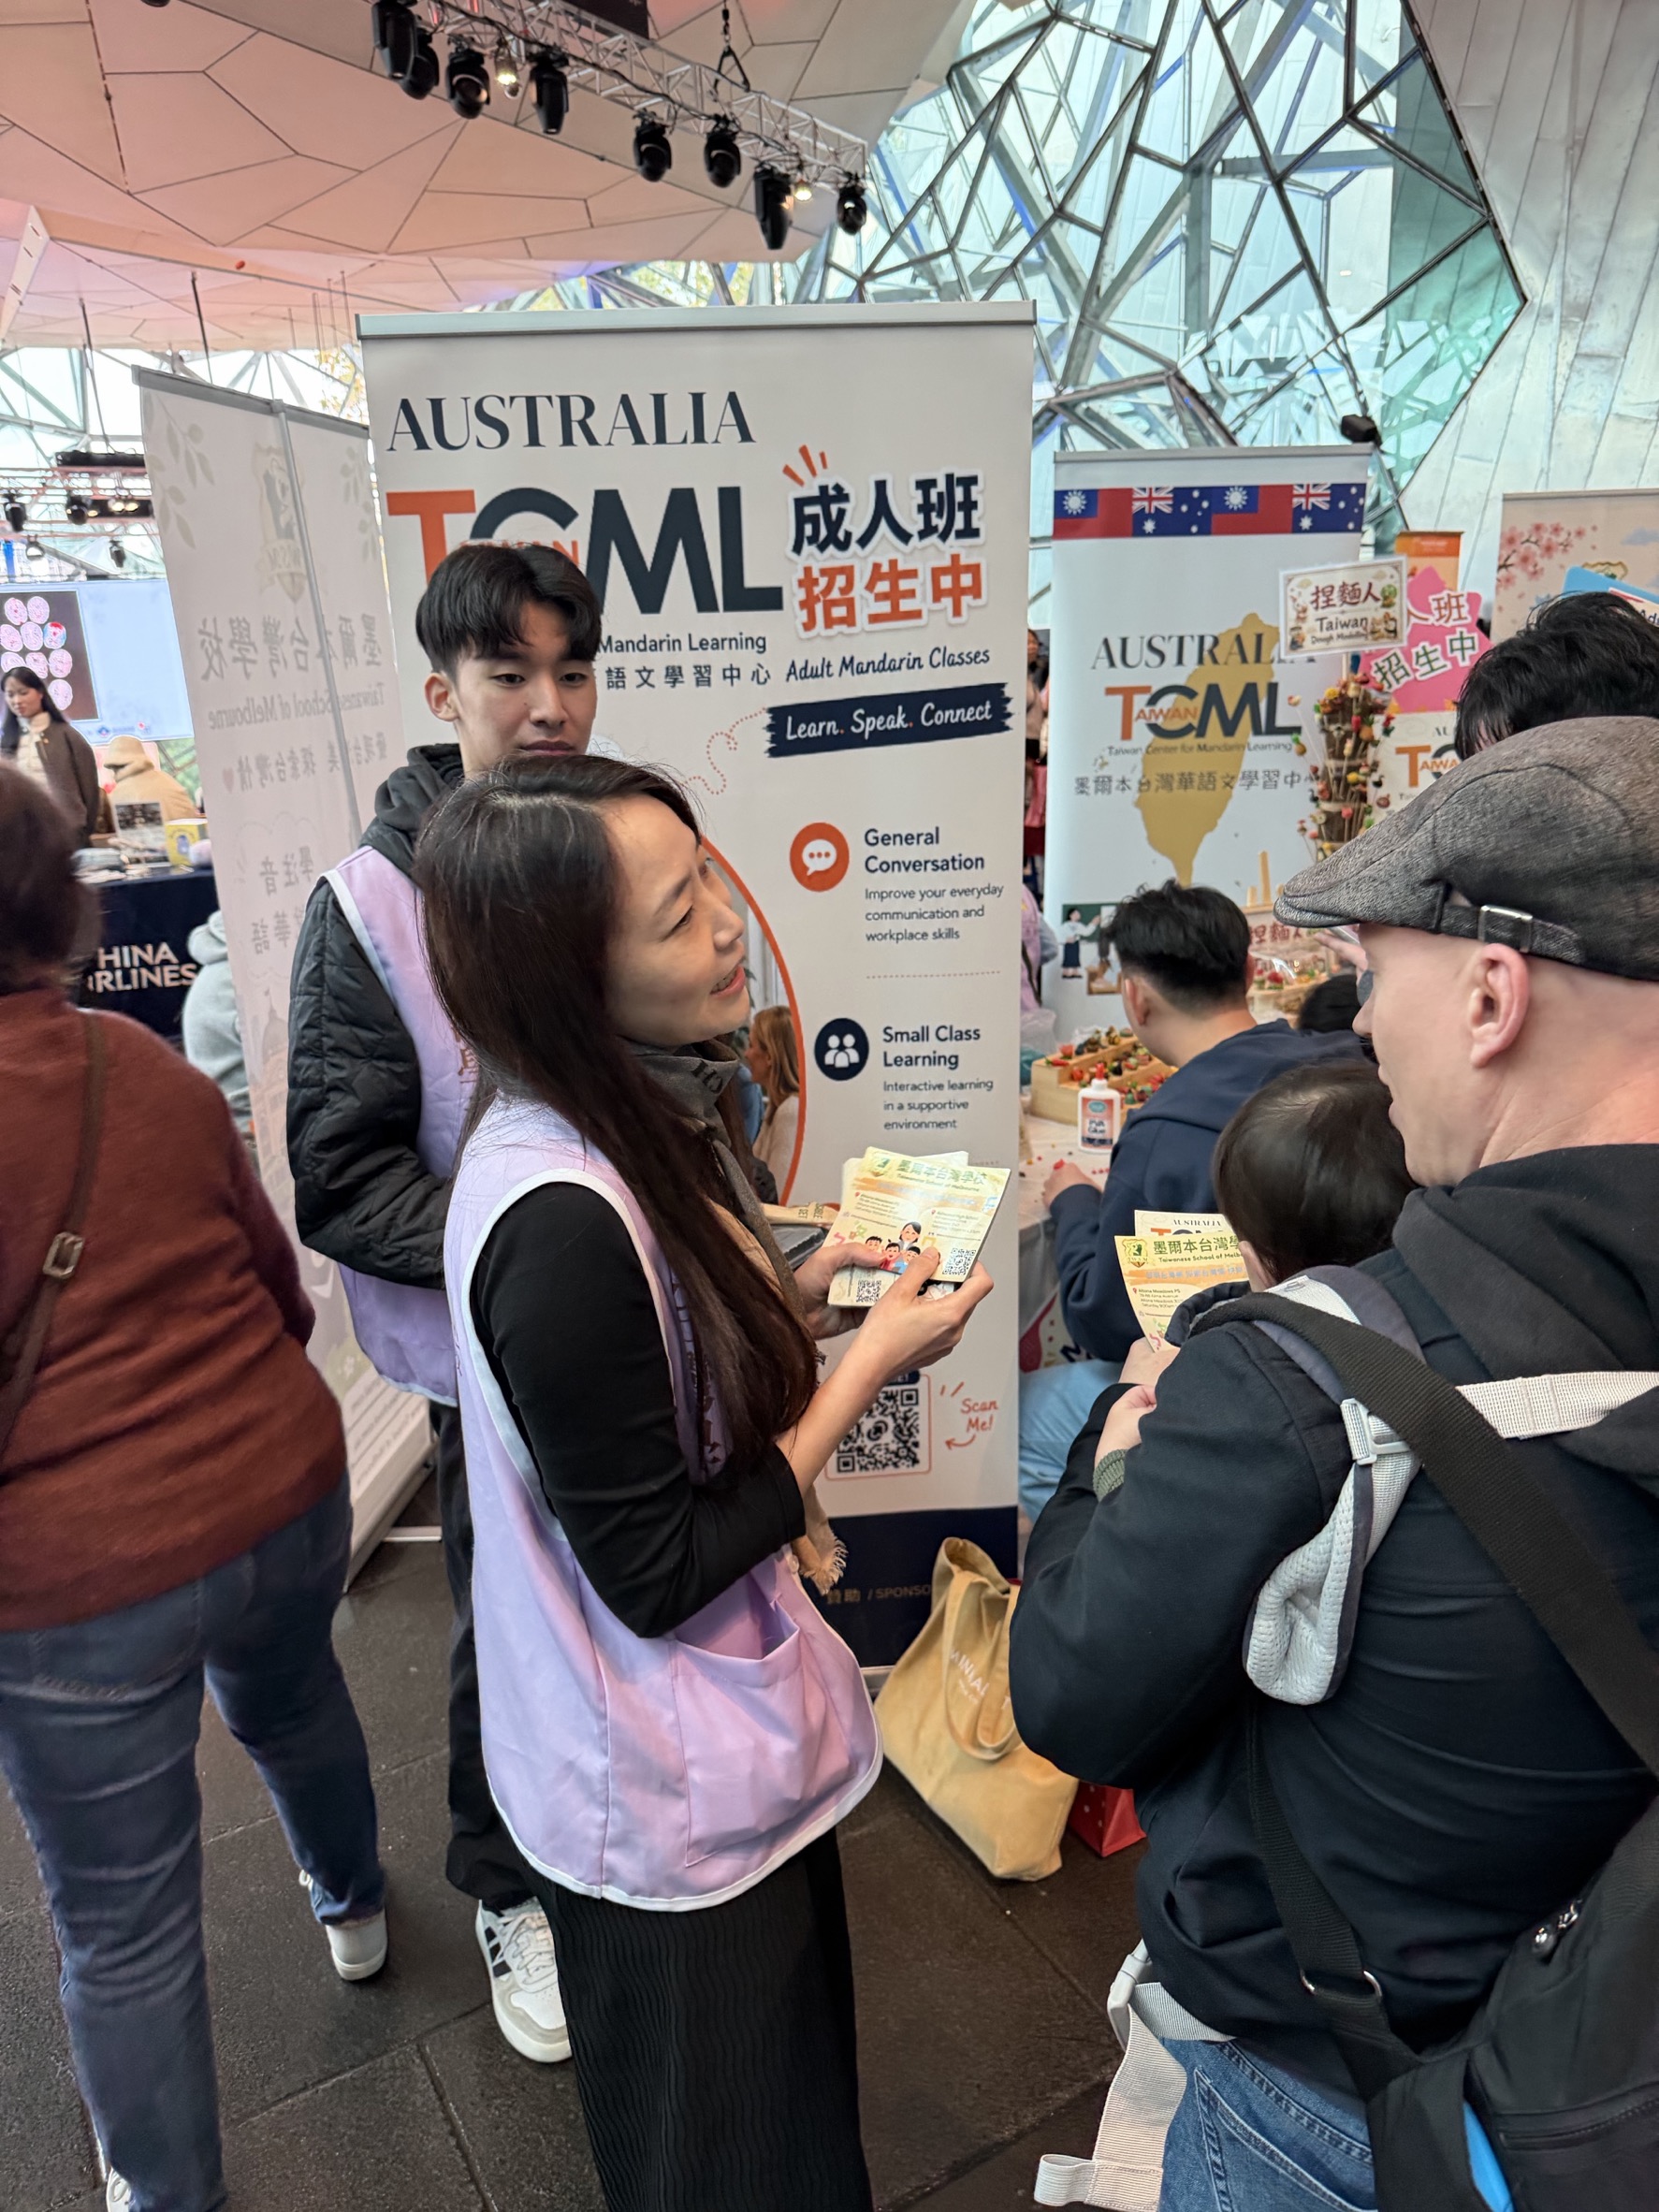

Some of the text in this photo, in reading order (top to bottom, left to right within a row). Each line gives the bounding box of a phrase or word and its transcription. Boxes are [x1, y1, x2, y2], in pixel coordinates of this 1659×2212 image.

[386, 391, 757, 452] AUSTRALIA
[791, 473, 981, 556] 成人班
[797, 553, 982, 633] 招生中
[1310, 581, 1381, 611] 捏麵人
[1315, 616, 1368, 633] Taiwan
[597, 632, 766, 654] Mandarin Learning
[1090, 632, 1317, 671] AUSTRAL
[786, 646, 990, 682] Adult Mandarin Classes
[1373, 630, 1478, 691] 招生中
[604, 662, 771, 691] 語文學習中心
[786, 700, 993, 740] Learn. Speak. Connect
[1105, 681, 1302, 741] TCML
[1108, 740, 1293, 756] Taiwan Center for Mandarin Learning
[864, 825, 939, 847] General
[864, 852, 985, 874] Conversation
[865, 882, 1005, 902] Improve your everyday
[865, 904, 985, 922] communication and
[865, 926, 960, 944] workplace skills
[97, 941, 180, 970] HINA
[87, 962, 197, 994] IRLINES
[882, 1025, 982, 1043] Small Class
[882, 1049, 960, 1070] Learning
[882, 1077, 994, 1092] Interactive learning
[882, 1099, 969, 1113] in a supportive
[883, 1118, 958, 1130] environment
[960, 1397, 998, 1415] Scan
[966, 1415, 994, 1433] Me!
[875, 1584, 931, 1599] SPONSO
